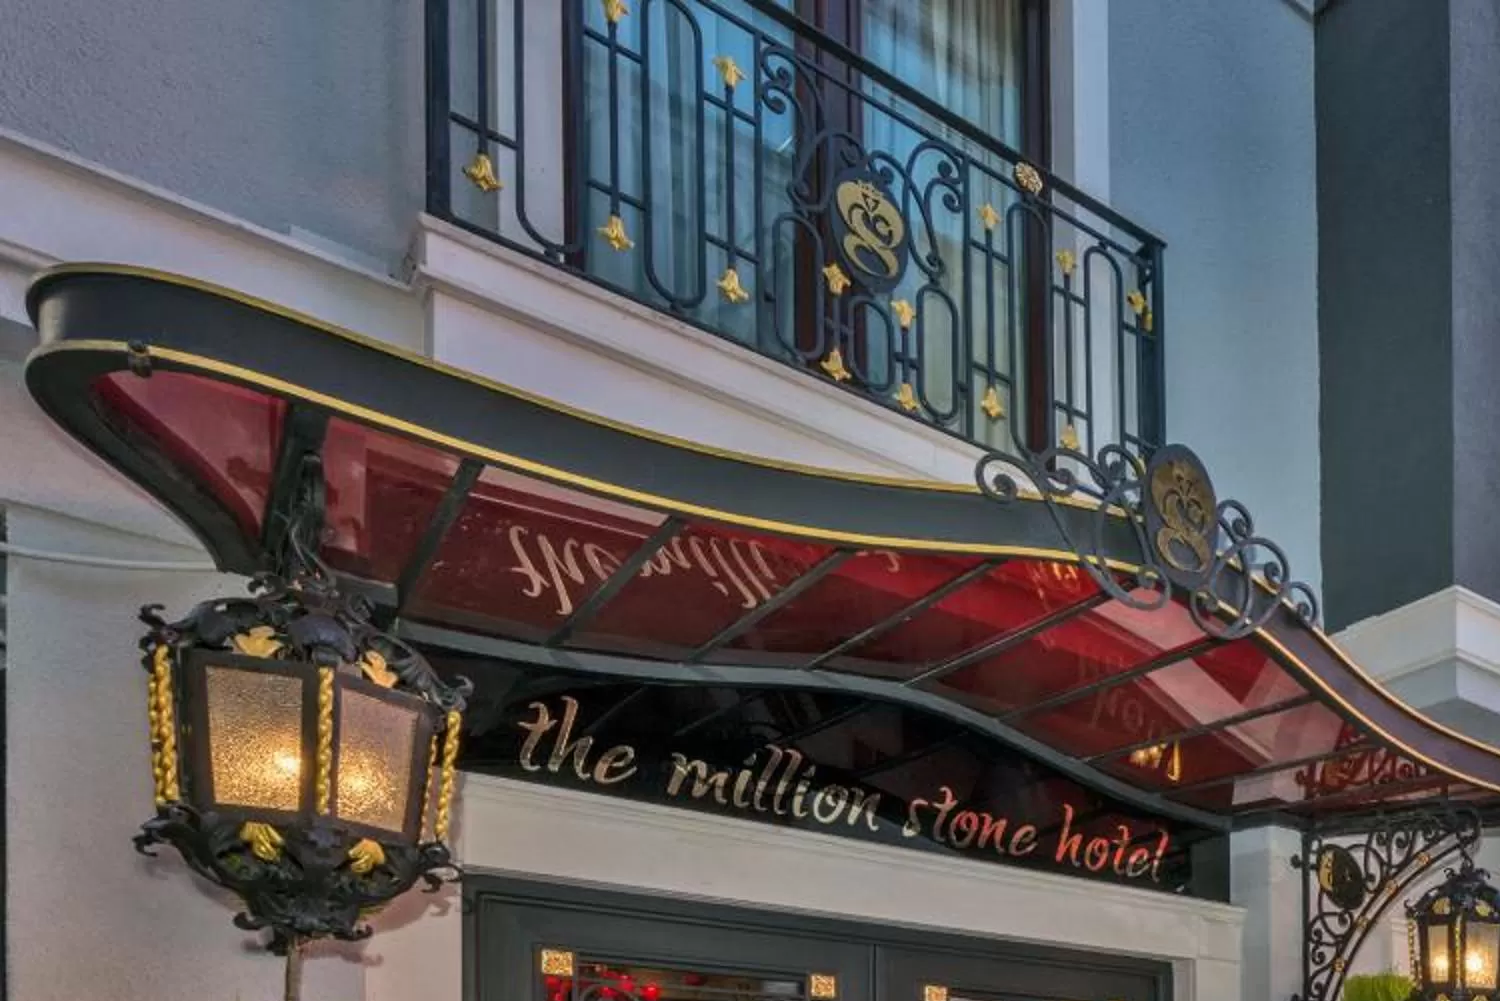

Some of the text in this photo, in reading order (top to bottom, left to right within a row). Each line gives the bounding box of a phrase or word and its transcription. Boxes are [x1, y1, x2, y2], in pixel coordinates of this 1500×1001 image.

[517, 695, 1169, 883] the million stone hotel
